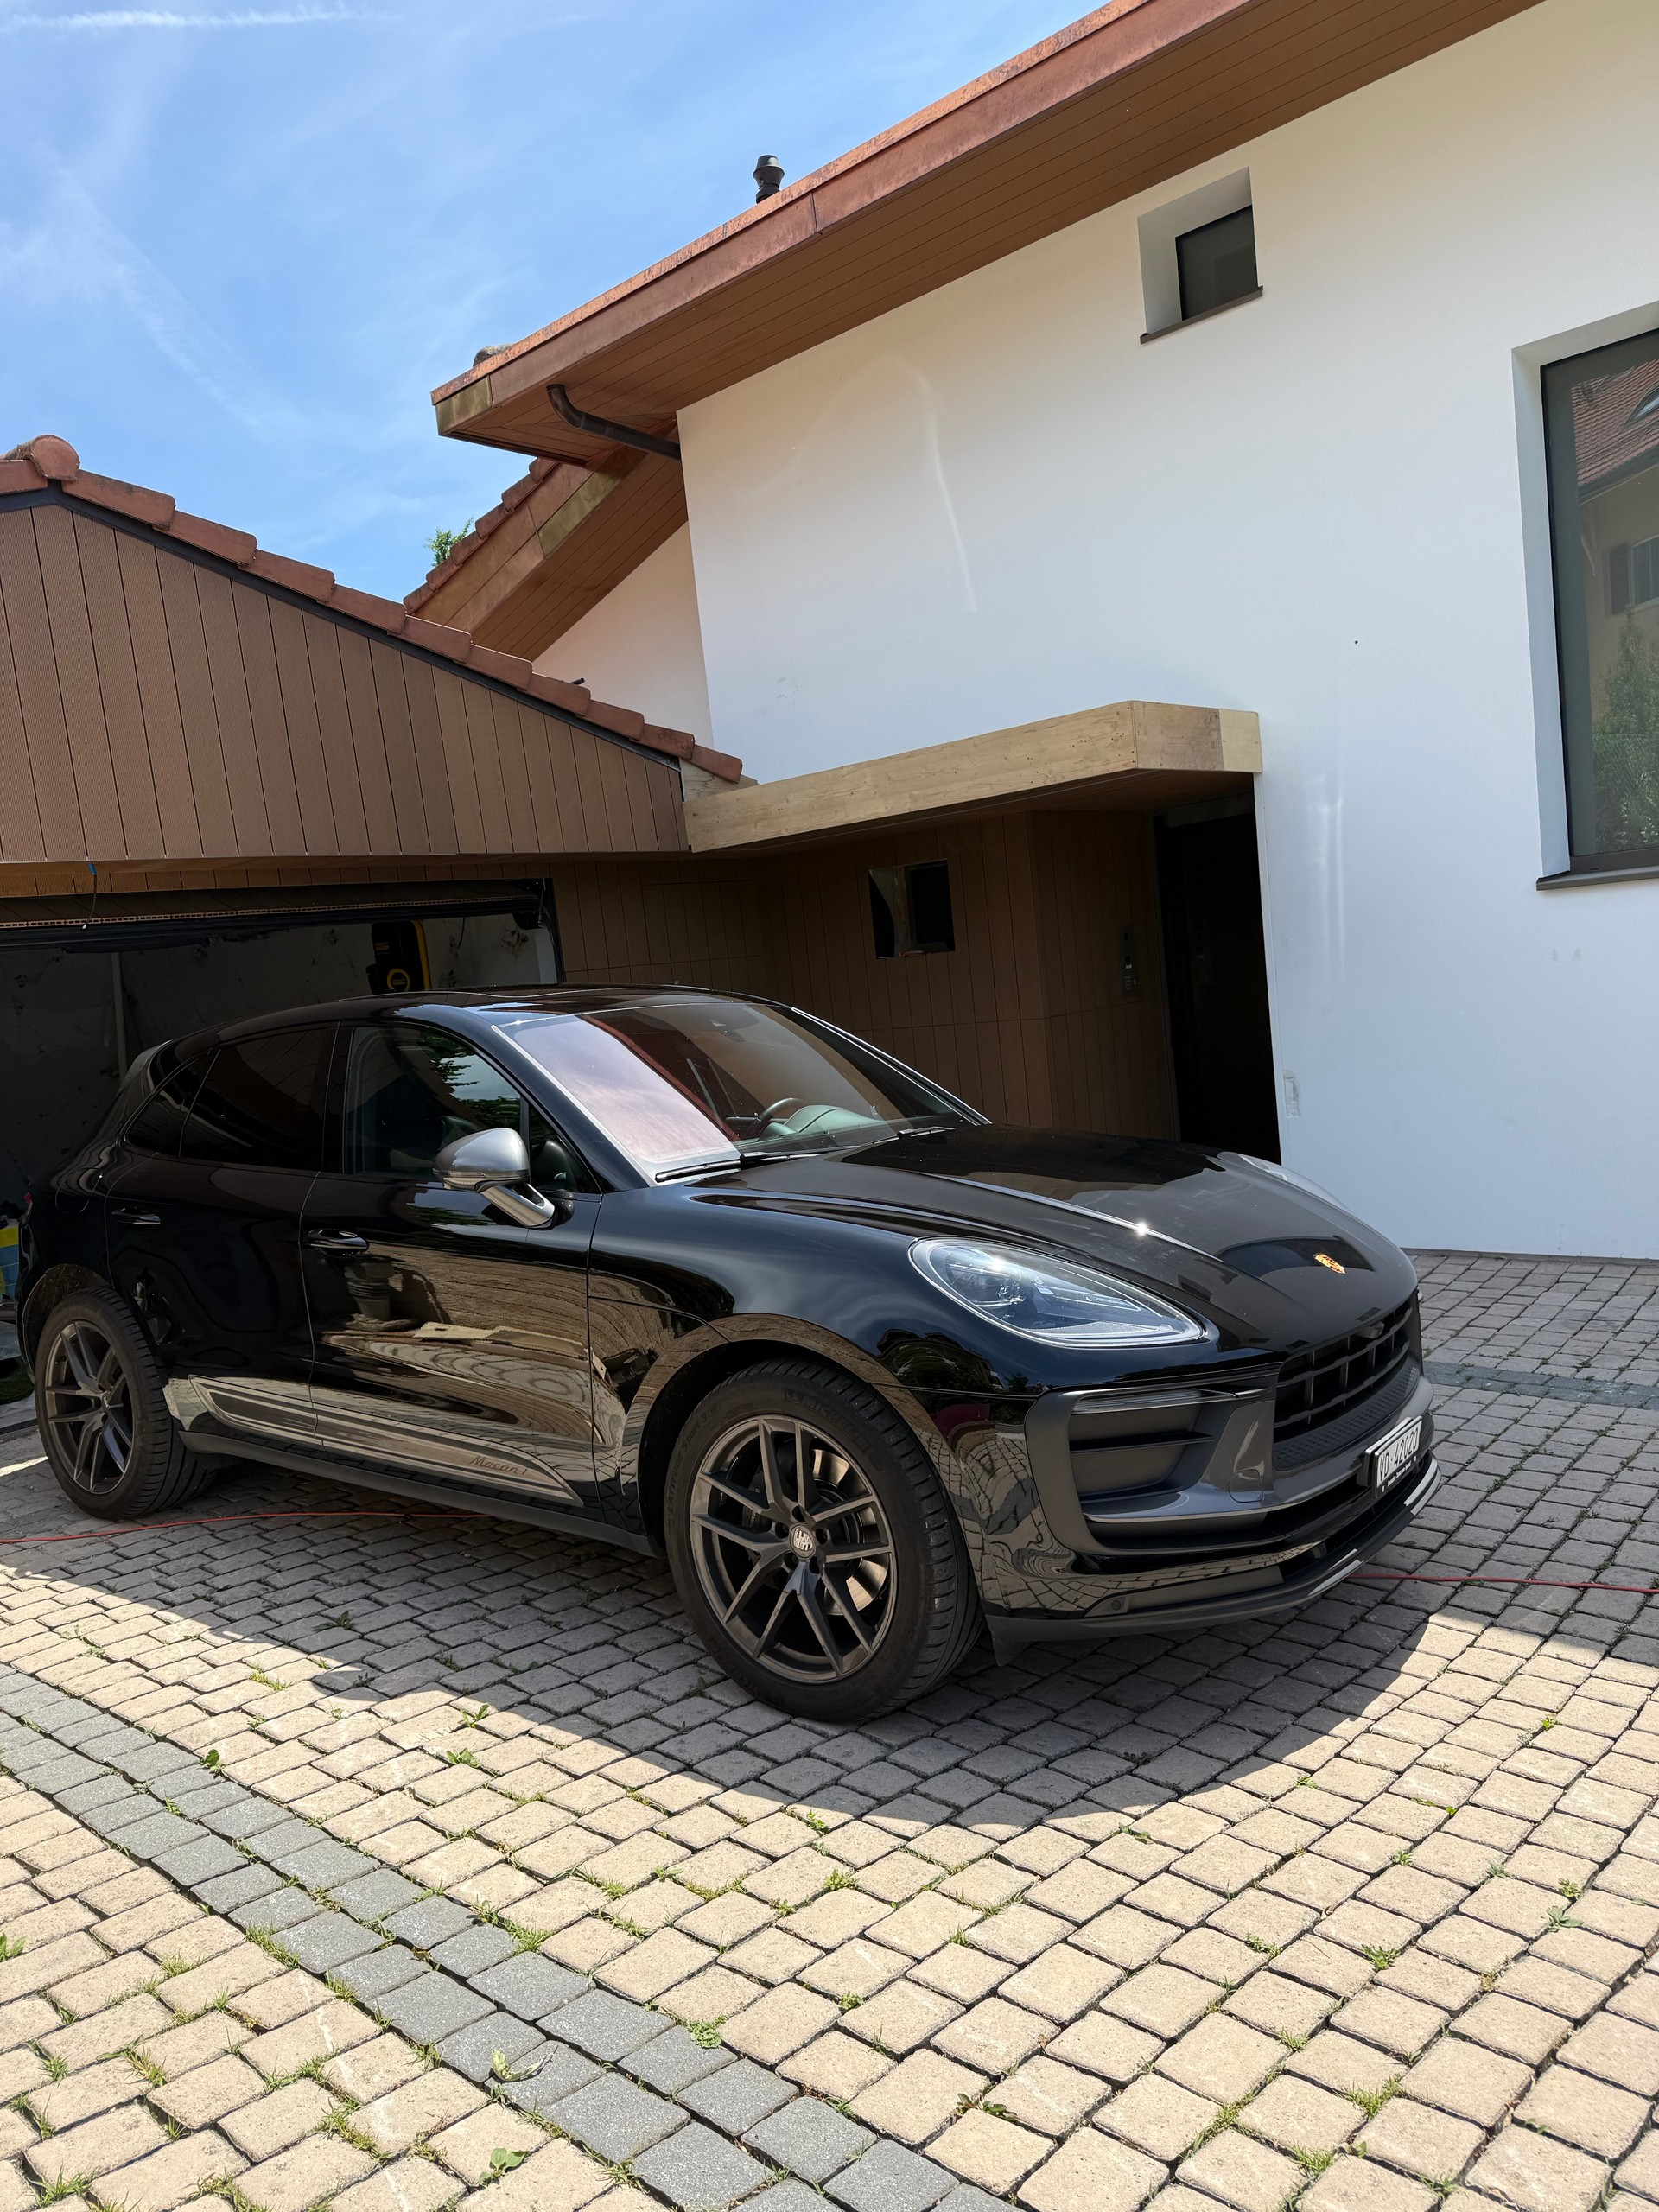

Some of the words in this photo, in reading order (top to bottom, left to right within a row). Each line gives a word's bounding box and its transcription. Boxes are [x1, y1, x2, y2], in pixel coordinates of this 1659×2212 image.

[468, 1455, 519, 1476] Macan
[667, 1451, 684, 1513] LATITUDE
[682, 1421, 701, 1452] Sport
